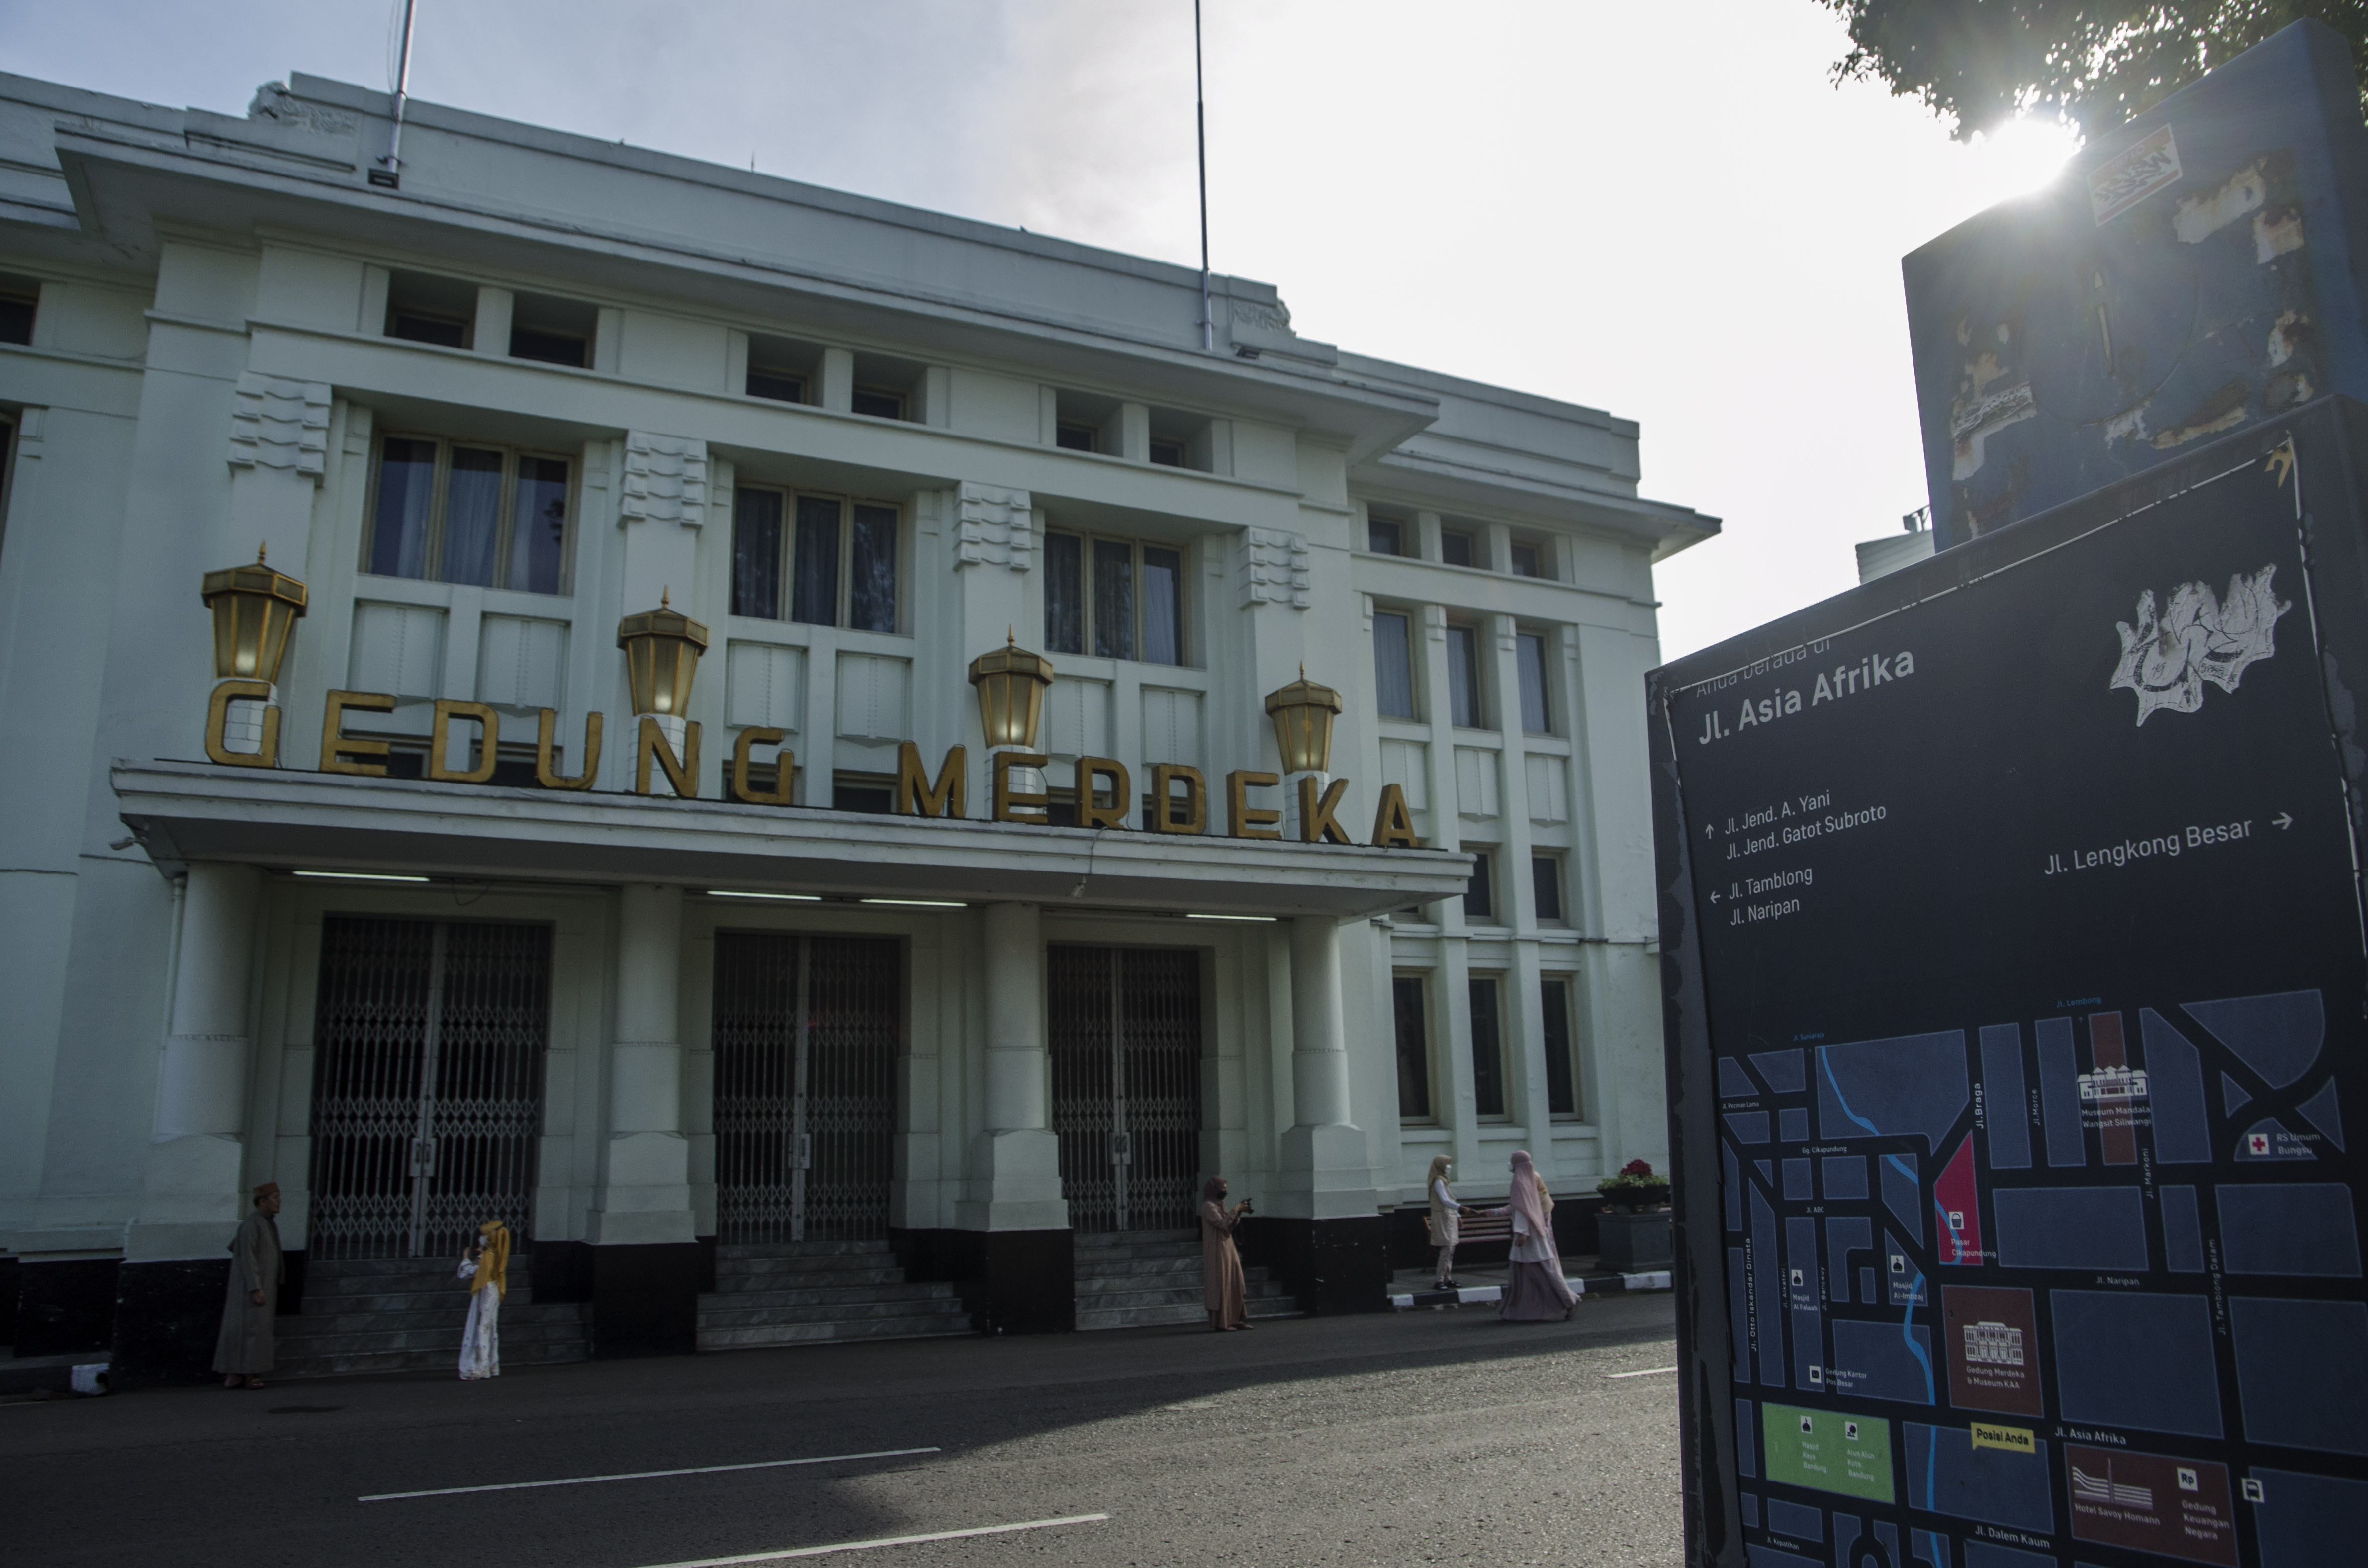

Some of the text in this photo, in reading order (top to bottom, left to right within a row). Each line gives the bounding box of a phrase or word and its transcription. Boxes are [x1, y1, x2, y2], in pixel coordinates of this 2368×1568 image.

[1699, 651, 1914, 744] Jl. Asia Afrika
[204, 680, 1420, 848] GEDUNG MERDEKA
[1725, 789, 1830, 835] Jl. Jend. A. Yani
[1727, 806, 1886, 860] Jl. Jend. Gatot Subroto
[2044, 820, 2252, 875] Jl. Lengkong Besar
[1729, 868, 1813, 900] Jl. Tamblong
[1730, 899, 1800, 926] Jl. Naripan
[2056, 997, 2102, 1008] Jl. Lembong
[2082, 1106, 2151, 1117] Museum Mandala
[2082, 1118, 2151, 1129] Wangsit Siliwangi
[2276, 1133, 2321, 1142] RS Umum
[2278, 1146, 2313, 1156] Bungsu
[2141, 1148, 2154, 1199] Jl. Markoni
[1952, 1249, 1996, 1259] Cikapundung
[1893, 1281, 1913, 1290] Masjid
[2096, 1276, 2139, 1286] Jl. Naripan
[2209, 1239, 2226, 1336] Jl. Tamblong Dalam
[1894, 1292, 1924, 1301] Al-Imtizaj
[1800, 1304, 1818, 1312] Falaah
[1825, 1368, 1867, 1379] Gedung Kantor
[1966, 1365, 2025, 1378] Gedung Merdeka
[1838, 1379, 1854, 1388] Besar
[1974, 1377, 2003, 1387] Museum
[2004, 1380, 2020, 1389] KAA
[1976, 1428, 2029, 1445] Posisi Anda
[2055, 1426, 2127, 1445] Jl. Asia Afrika
[1802, 1442, 1819, 1451] Masjid
[1803, 1461, 1827, 1474] Bandung
[1847, 1459, 1861, 1468] Kota
[1848, 1469, 1874, 1482] Bandung
[2181, 1472, 2194, 1485] Rp
[2181, 1499, 2217, 1515] Gedung
[2075, 1503, 2161, 1526] Hotel Savoy Homann
[2183, 1513, 2230, 1529] Keuangan
[1975, 1524, 2050, 1549] Jl. Dalem Kaum
[2185, 1526, 2218, 1540] Negara
[1773, 1537, 1799, 1551] Kepatihan
